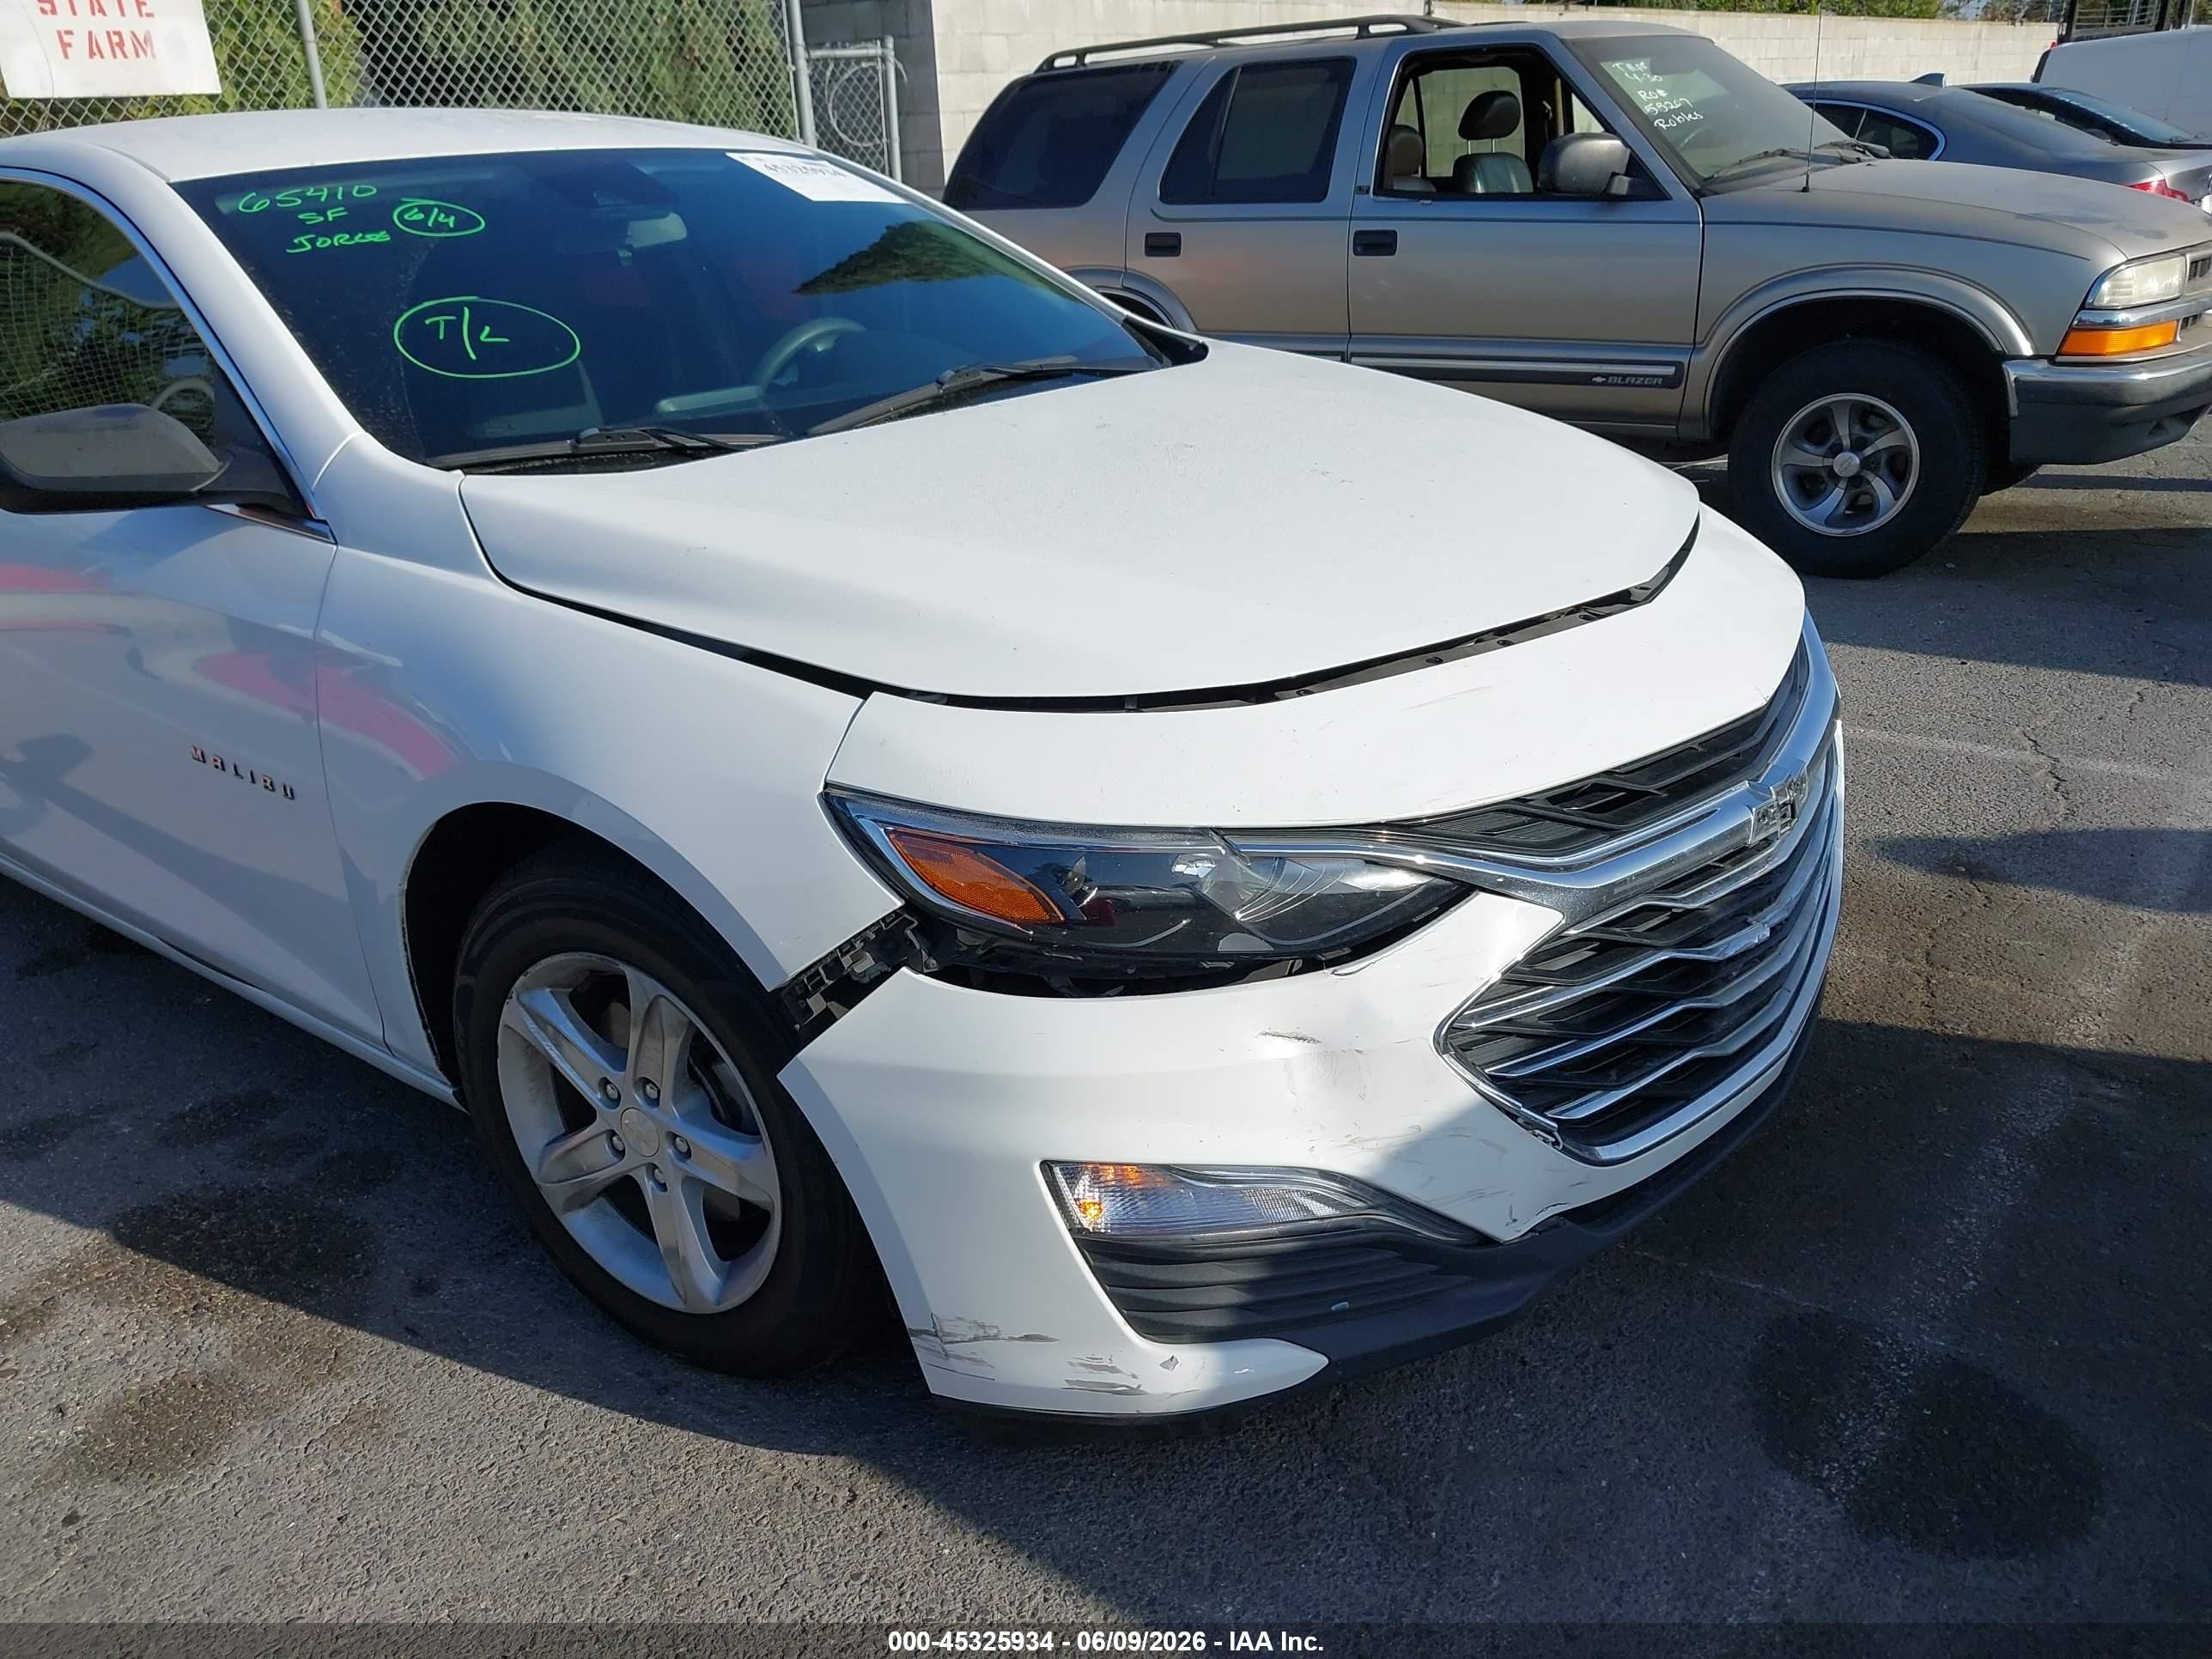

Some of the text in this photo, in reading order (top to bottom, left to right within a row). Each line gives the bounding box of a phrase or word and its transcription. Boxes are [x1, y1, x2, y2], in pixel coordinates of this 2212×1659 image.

[56, 29, 155, 59] FARM
[1654, 111, 1704, 130] Robles
[238, 185, 377, 213] 65410
[297, 207, 348, 224] SF
[404, 208, 455, 228] 6/4
[425, 307, 510, 361] T/L
[1607, 375, 1663, 386] BLAZER
[191, 744, 295, 800] MALIBU
